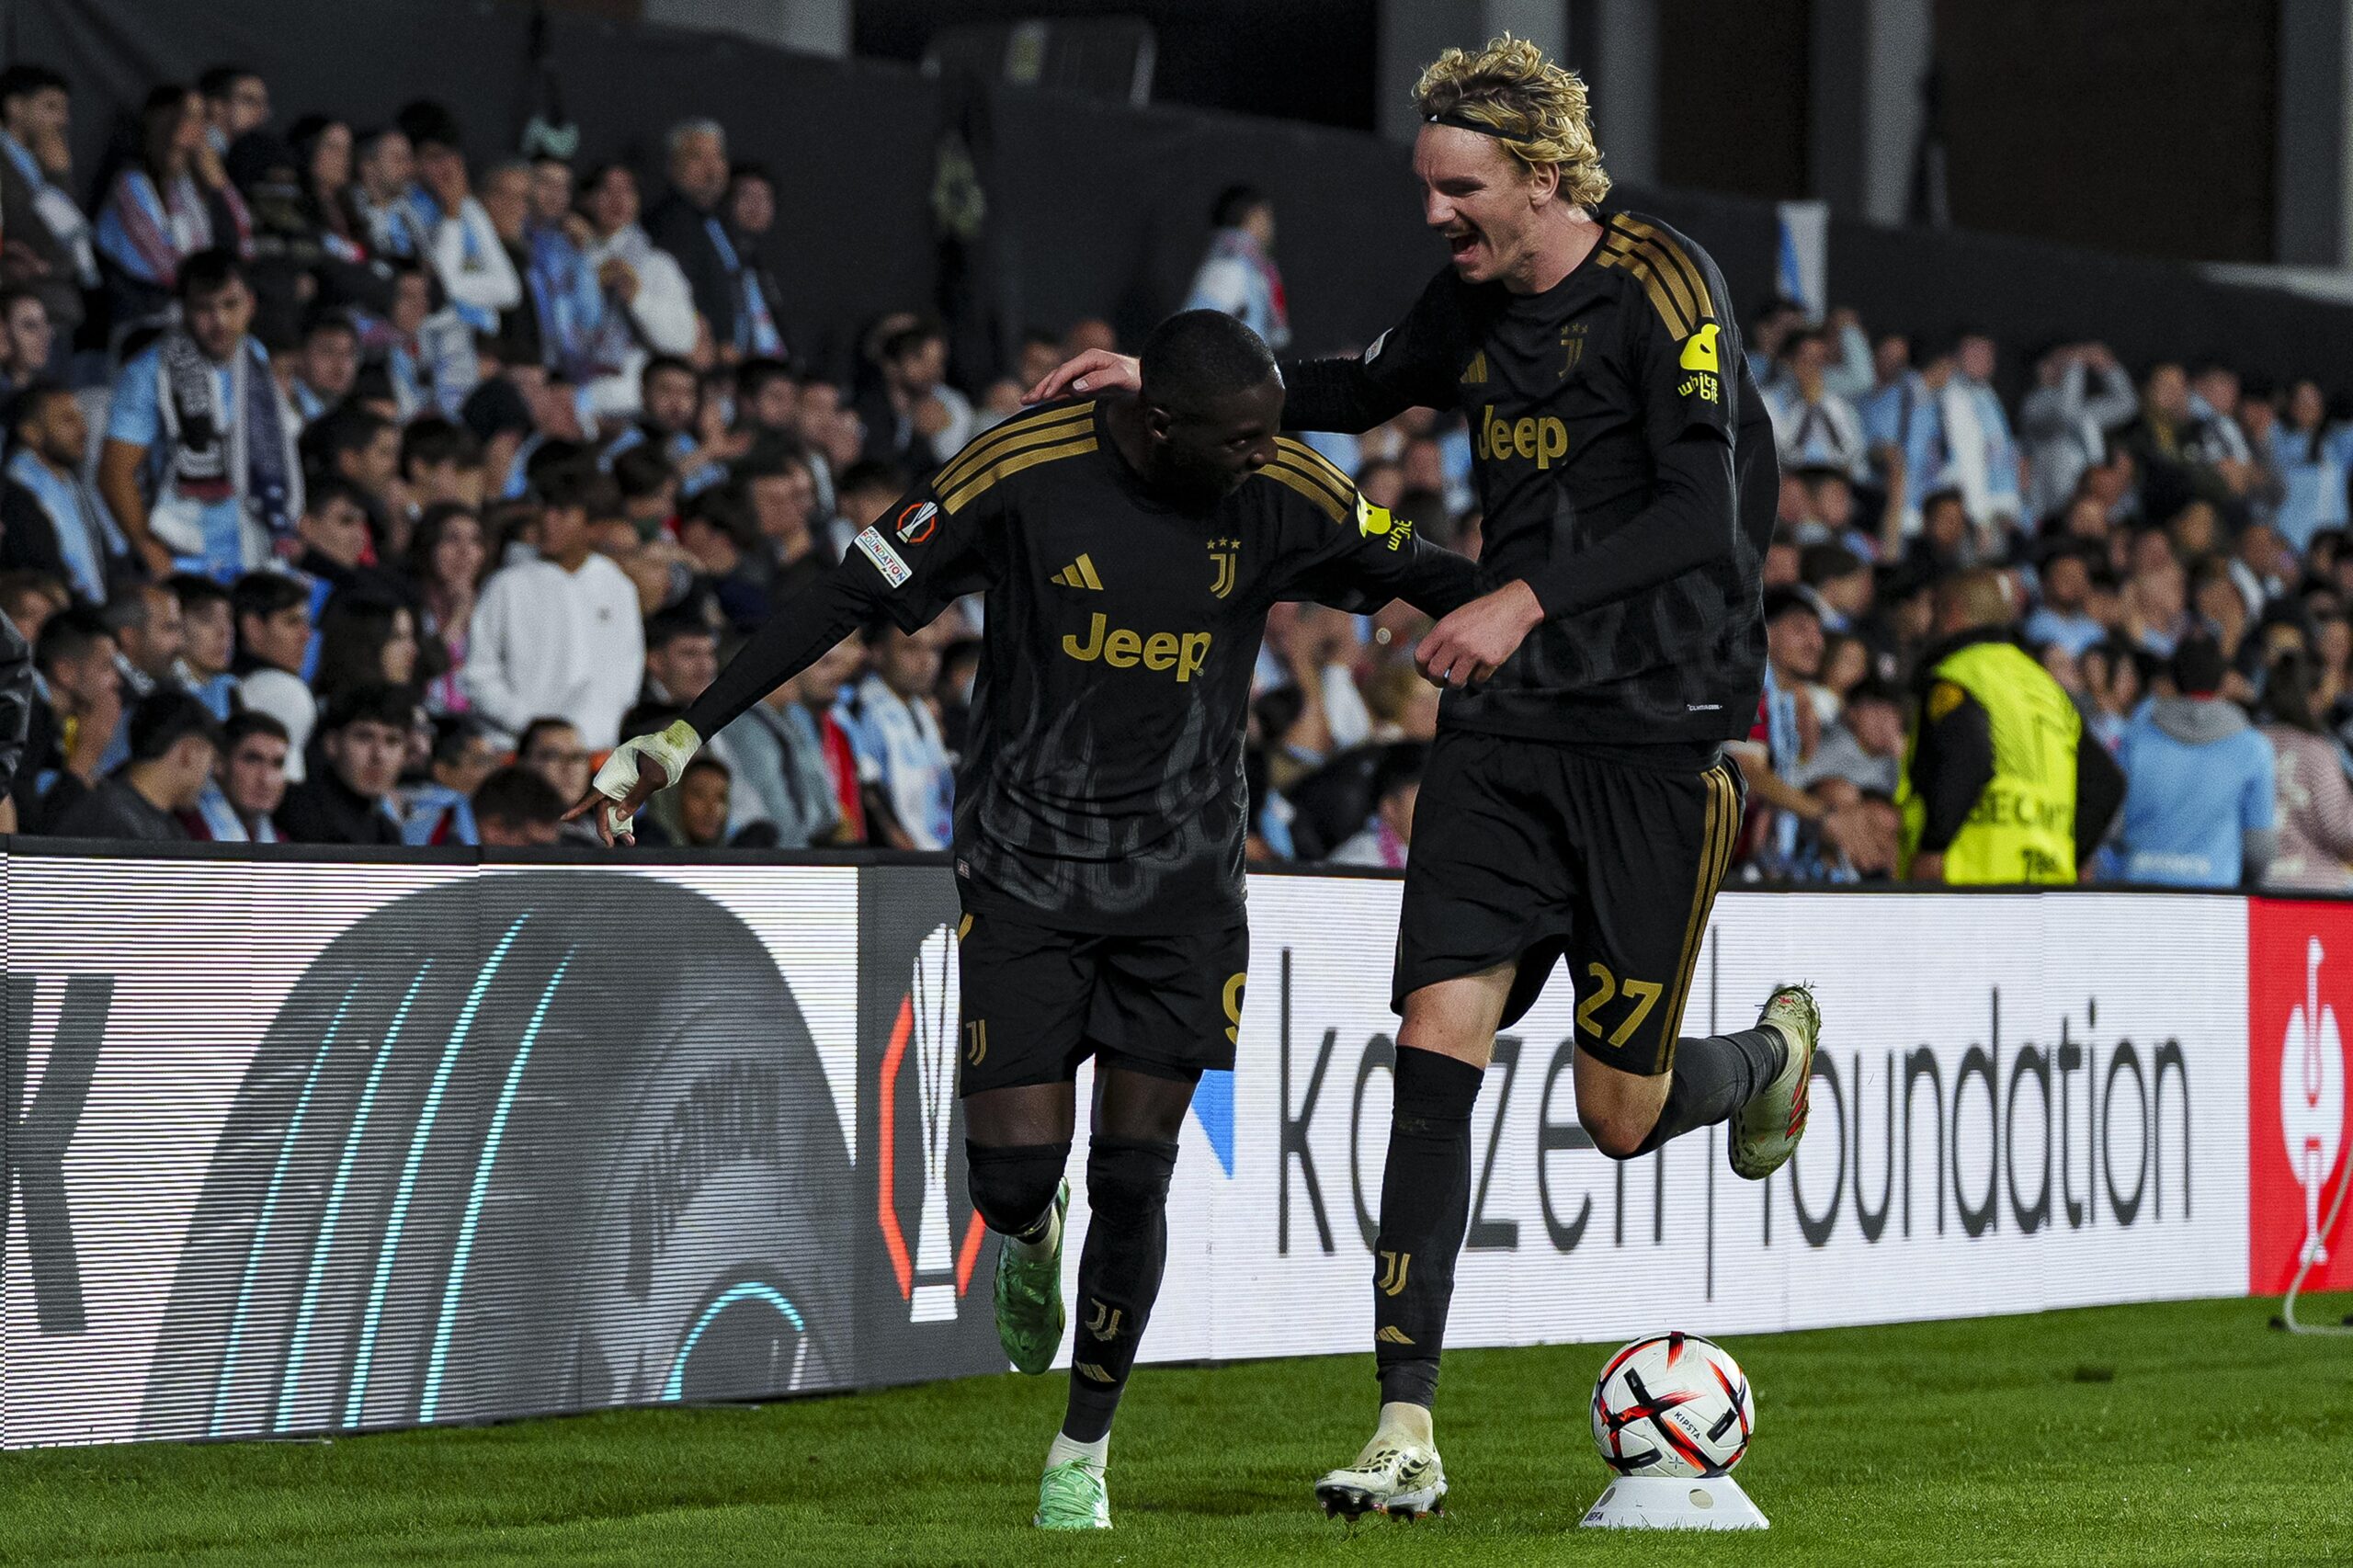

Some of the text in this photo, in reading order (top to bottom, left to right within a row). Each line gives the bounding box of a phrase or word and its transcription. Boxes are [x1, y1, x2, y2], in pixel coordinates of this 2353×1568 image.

[1478, 404, 1568, 470] Jeep
[861, 530, 905, 583] FOUNDATION
[1063, 612, 1212, 682] Jeep
[1576, 961, 1664, 1048] 27
[1762, 983, 2193, 1248] oundation
[1674, 1411, 1701, 1440] KIPSTA
